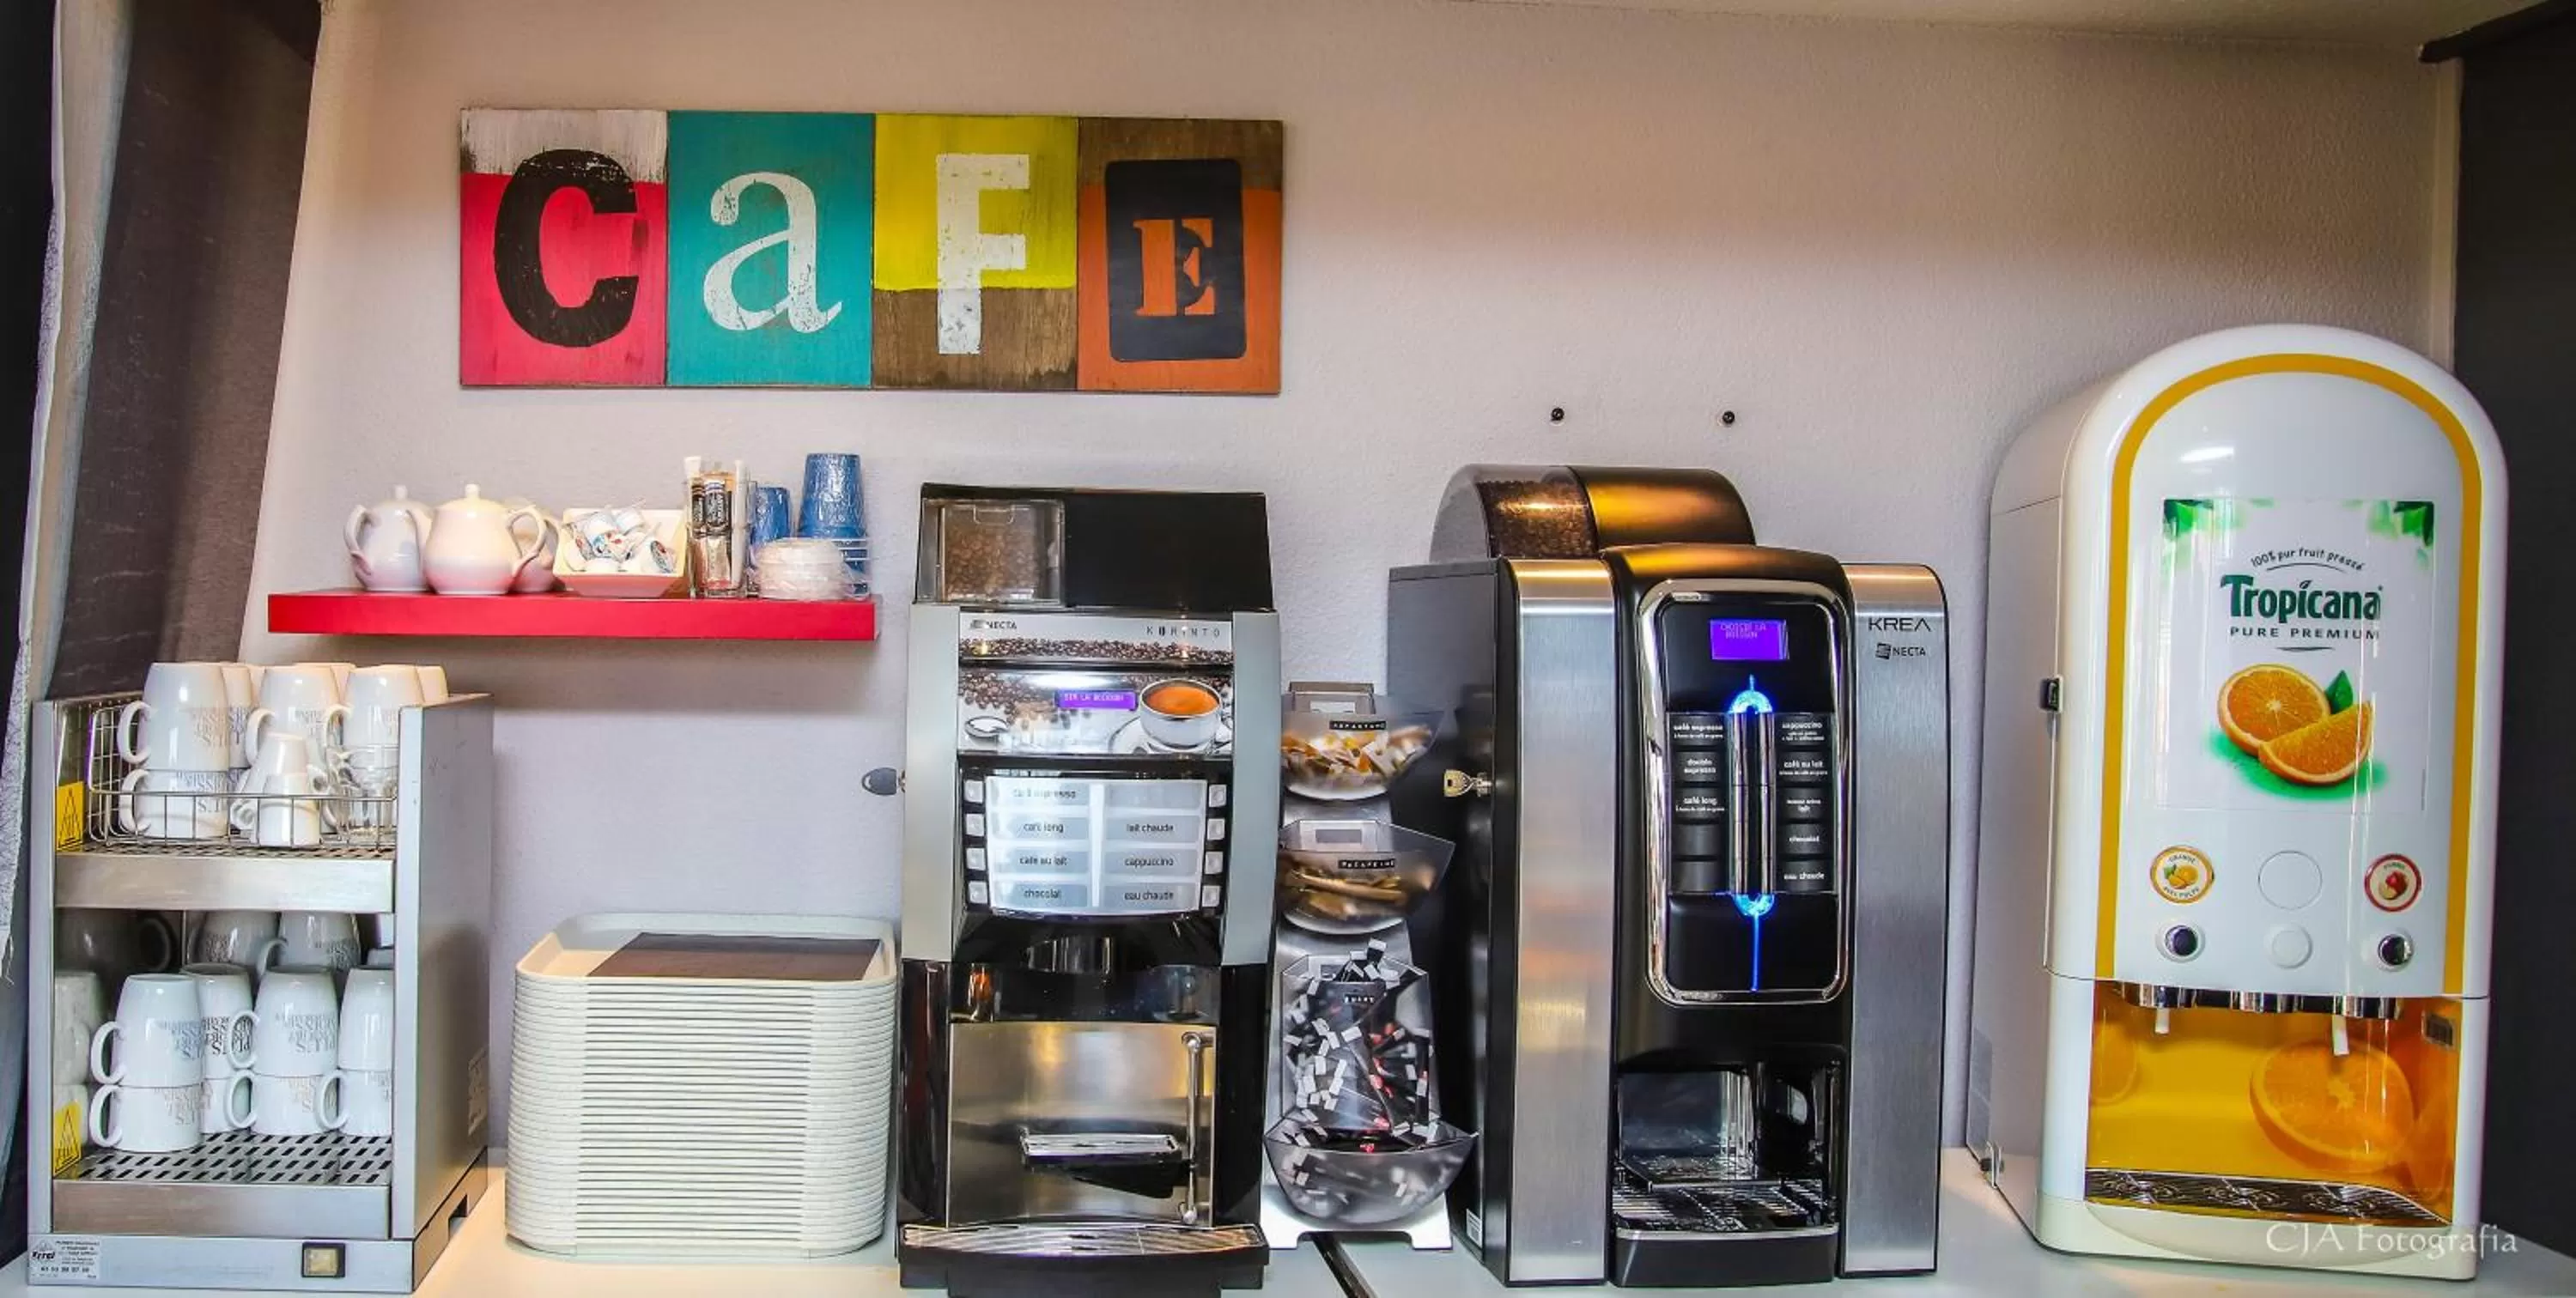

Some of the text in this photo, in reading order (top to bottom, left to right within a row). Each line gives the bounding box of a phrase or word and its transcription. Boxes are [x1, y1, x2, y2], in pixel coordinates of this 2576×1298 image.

[2251, 551, 2275, 567] 100%
[2277, 549, 2295, 561] pur
[2298, 547, 2325, 559] fruit
[2220, 574, 2381, 623] Tropicana
[987, 620, 1018, 629] NECTA
[1868, 617, 1931, 632] KREA
[2230, 627, 2379, 640] PURE PREMIUM
[1893, 646, 1926, 656] NECTA
[1043, 821, 1064, 834] long
[1124, 858, 1174, 868] cappuccino
